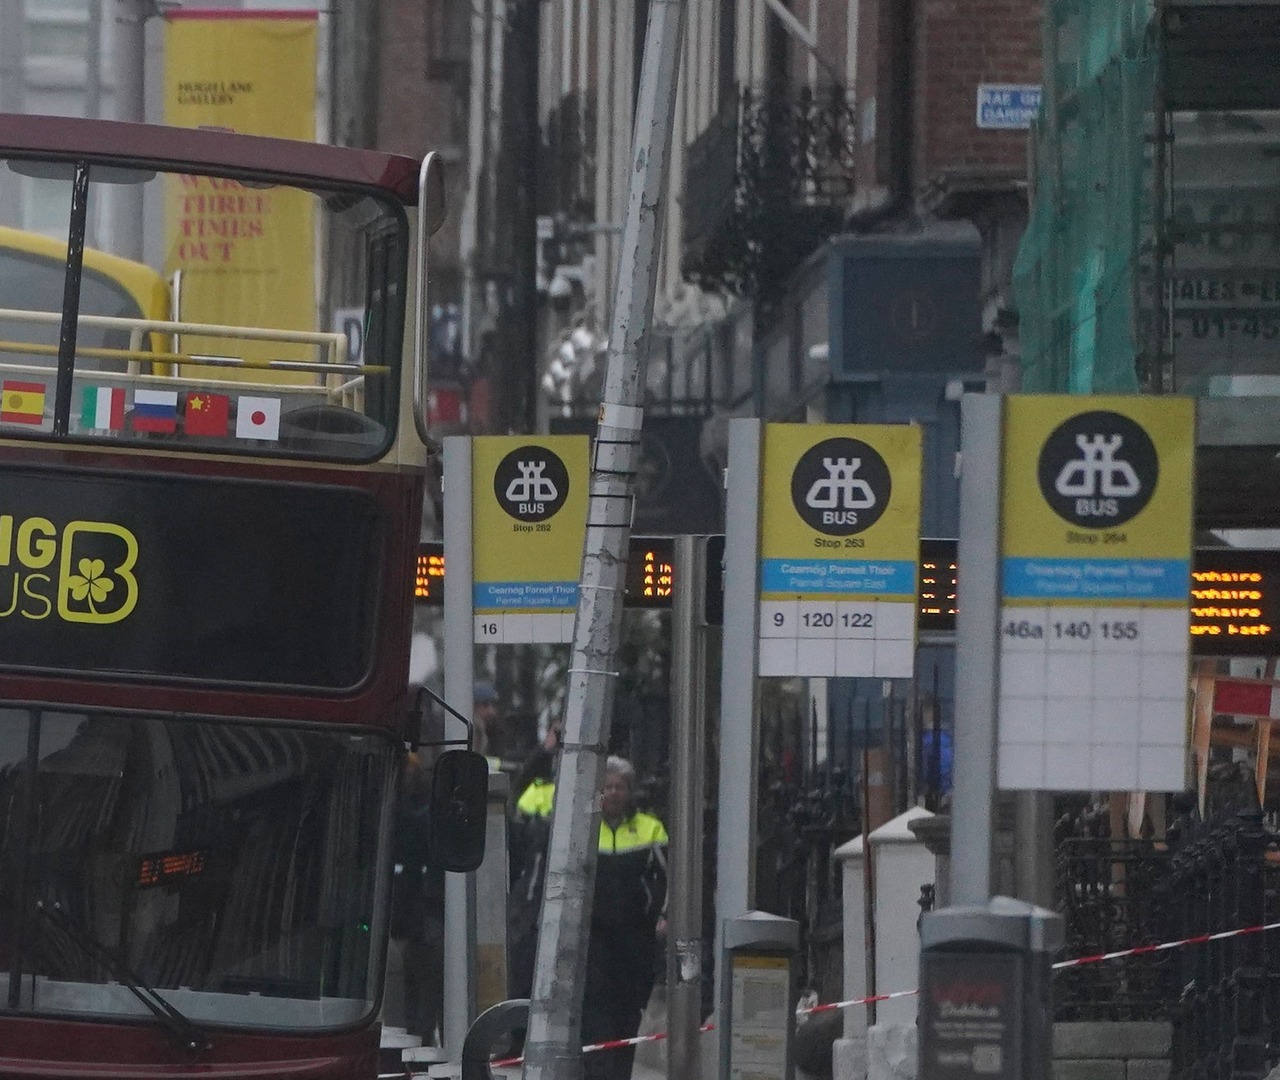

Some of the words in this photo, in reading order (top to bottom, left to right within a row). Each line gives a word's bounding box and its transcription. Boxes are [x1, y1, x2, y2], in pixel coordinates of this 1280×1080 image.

[178, 194, 272, 214] THREE
[179, 217, 264, 238] TIMES
[178, 241, 235, 262] OUT
[519, 503, 545, 515] BUS
[1075, 499, 1119, 517] BUS
[823, 511, 859, 525] BUS
[513, 524, 534, 534] Stop
[814, 537, 841, 549] Stop
[844, 538, 865, 548] 263
[829, 564, 867, 575] Parnell
[868, 565, 896, 576] Thoir
[790, 578, 825, 588] Parnell
[827, 579, 863, 590] Square
[864, 578, 887, 590] East
[773, 612, 785, 628] 9
[802, 613, 834, 627] 120
[842, 613, 873, 628] 122
[482, 623, 497, 635] 16
[1054, 620, 1091, 640] 140
[1101, 620, 1138, 641] 155
